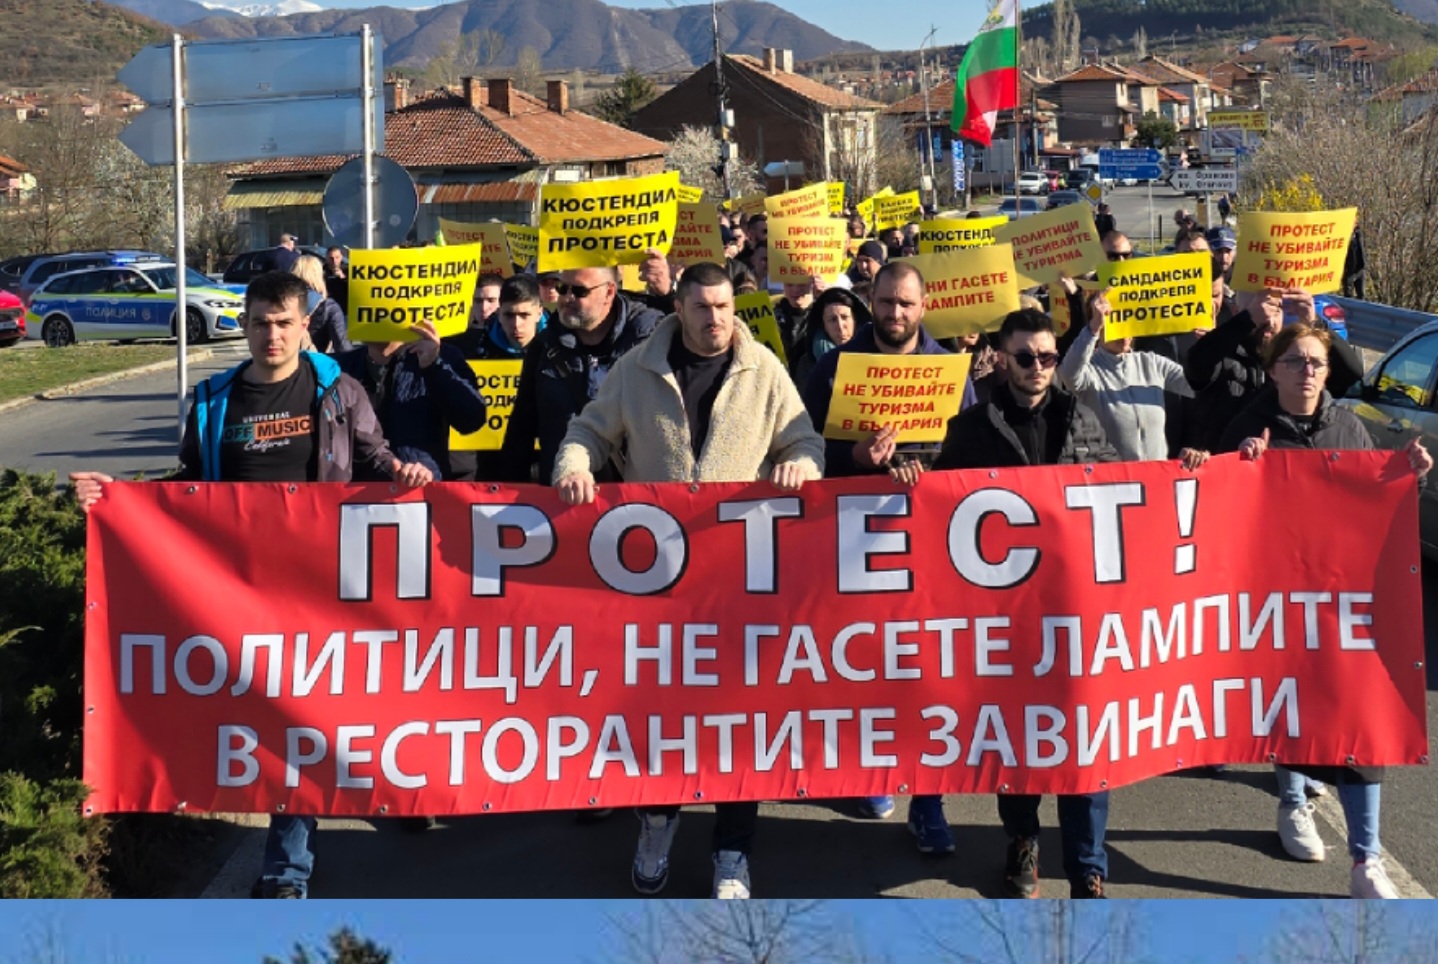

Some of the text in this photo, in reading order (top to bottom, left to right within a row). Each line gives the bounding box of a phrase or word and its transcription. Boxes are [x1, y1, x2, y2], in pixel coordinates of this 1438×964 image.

[543, 187, 676, 213] КЮСТЕНДИЛ
[562, 210, 660, 231] ПОДКРЕПЯ
[1270, 222, 1336, 237] ПРОТЕСТ
[788, 226, 835, 236] ПРОТЕСТ
[920, 229, 992, 241] КЮСТЕНД
[1012, 220, 1079, 246] ПОЛИТИЦИ
[548, 229, 667, 253] ПРОТЕСТА
[774, 240, 791, 250] НЕ
[1026, 232, 1091, 257] УБИВАЙТЕ
[1248, 237, 1345, 254] НЕ УБИВАЙТЕ
[351, 259, 477, 280] КЮСТЕНДИЛ
[1023, 249, 1083, 271] ТУРИЗМА
[1264, 257, 1329, 271] ТУРИЗМА
[925, 272, 1008, 293] НИ ГАСЕТЕ
[1109, 267, 1203, 287] САНДАНСКИ
[1247, 271, 1335, 289] В БЪЛГАРИЯ
[371, 281, 462, 300] ПОДКРЕПЯ
[1119, 284, 1196, 302] ПОДКРЕПЯ
[86, 306, 136, 318] ПОЛИЦИЯ
[357, 301, 465, 324] ПРОТЕСТА
[1110, 302, 1206, 323] ПРОТЕСТА
[866, 366, 943, 379] ПРОТЕСТ
[843, 381, 956, 398] НЕ УБИВАЙТЕ
[858, 401, 935, 416] ТУРИЗМА
[257, 418, 311, 437] MUSIC
[842, 418, 853, 430] В
[339, 478, 1199, 600] ПРОТЕСТ!
[120, 591, 1377, 704] ПОЛИТИЦИ, НЕ ГАСЕТЕ ЛАМПИТЕ
[216, 677, 1300, 789] В РЕСТОРАНТИТЕ ЗАВИНАГИ
